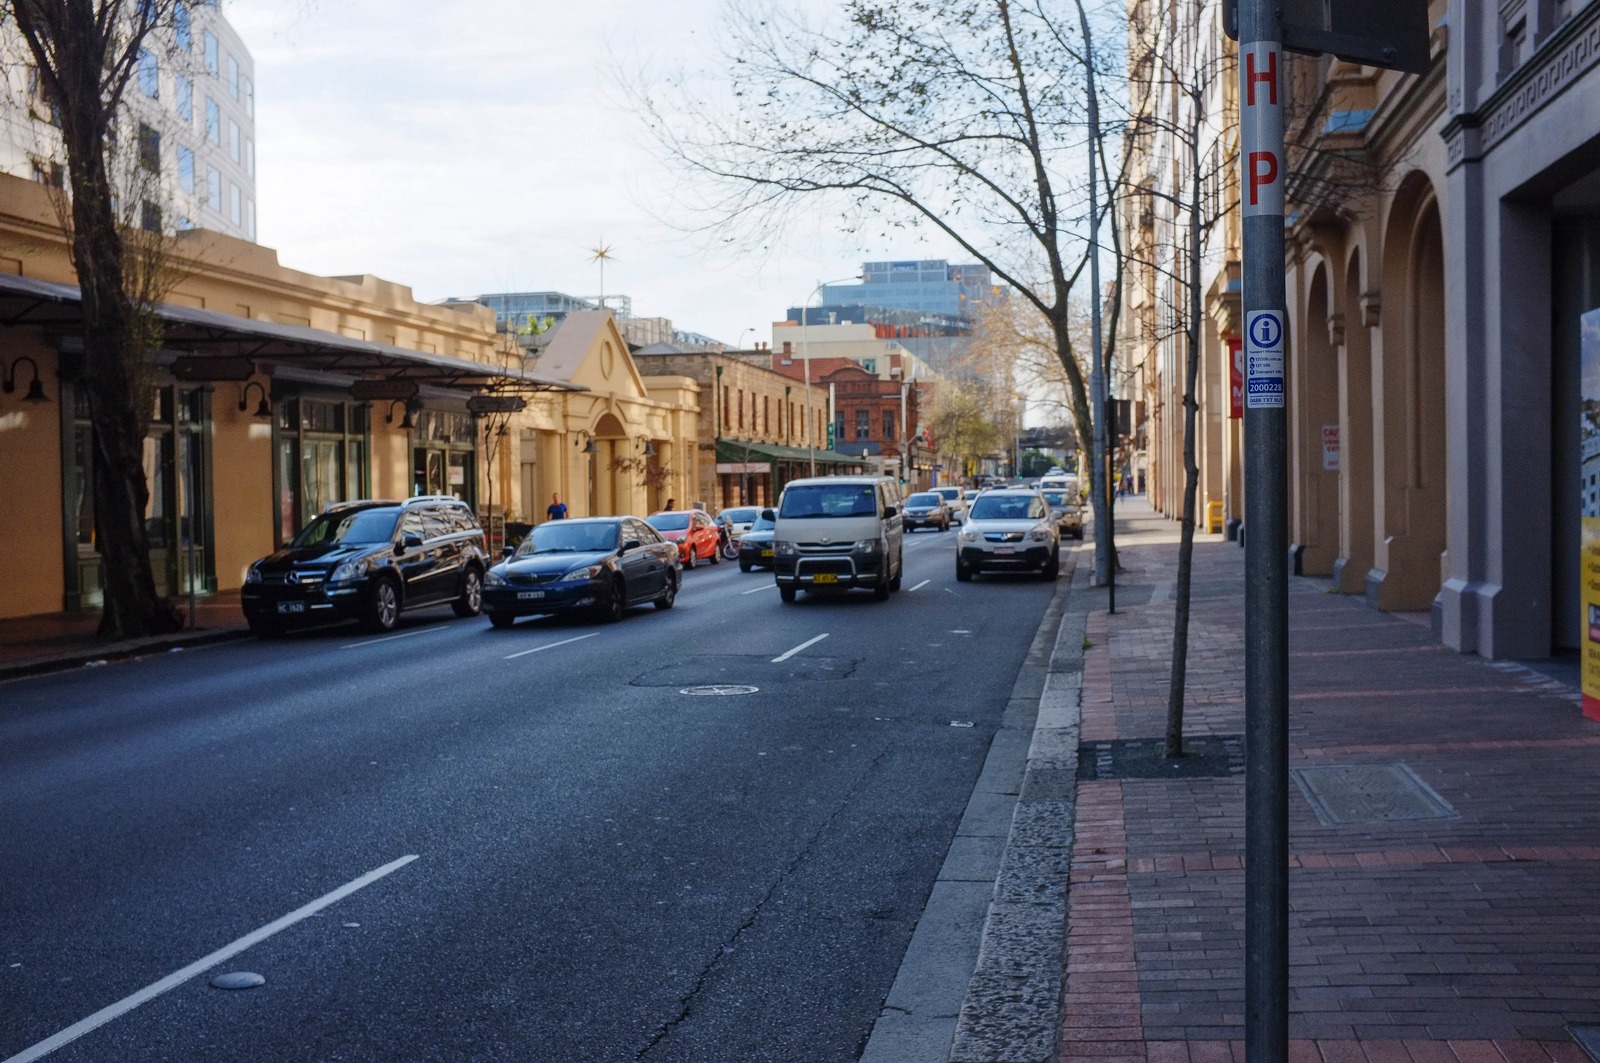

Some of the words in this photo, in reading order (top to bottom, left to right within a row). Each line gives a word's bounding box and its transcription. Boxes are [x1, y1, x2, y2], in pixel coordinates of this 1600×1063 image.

[1246, 52, 1277, 106] H
[1249, 151, 1278, 206] P
[1249, 383, 1283, 392] 2000228
